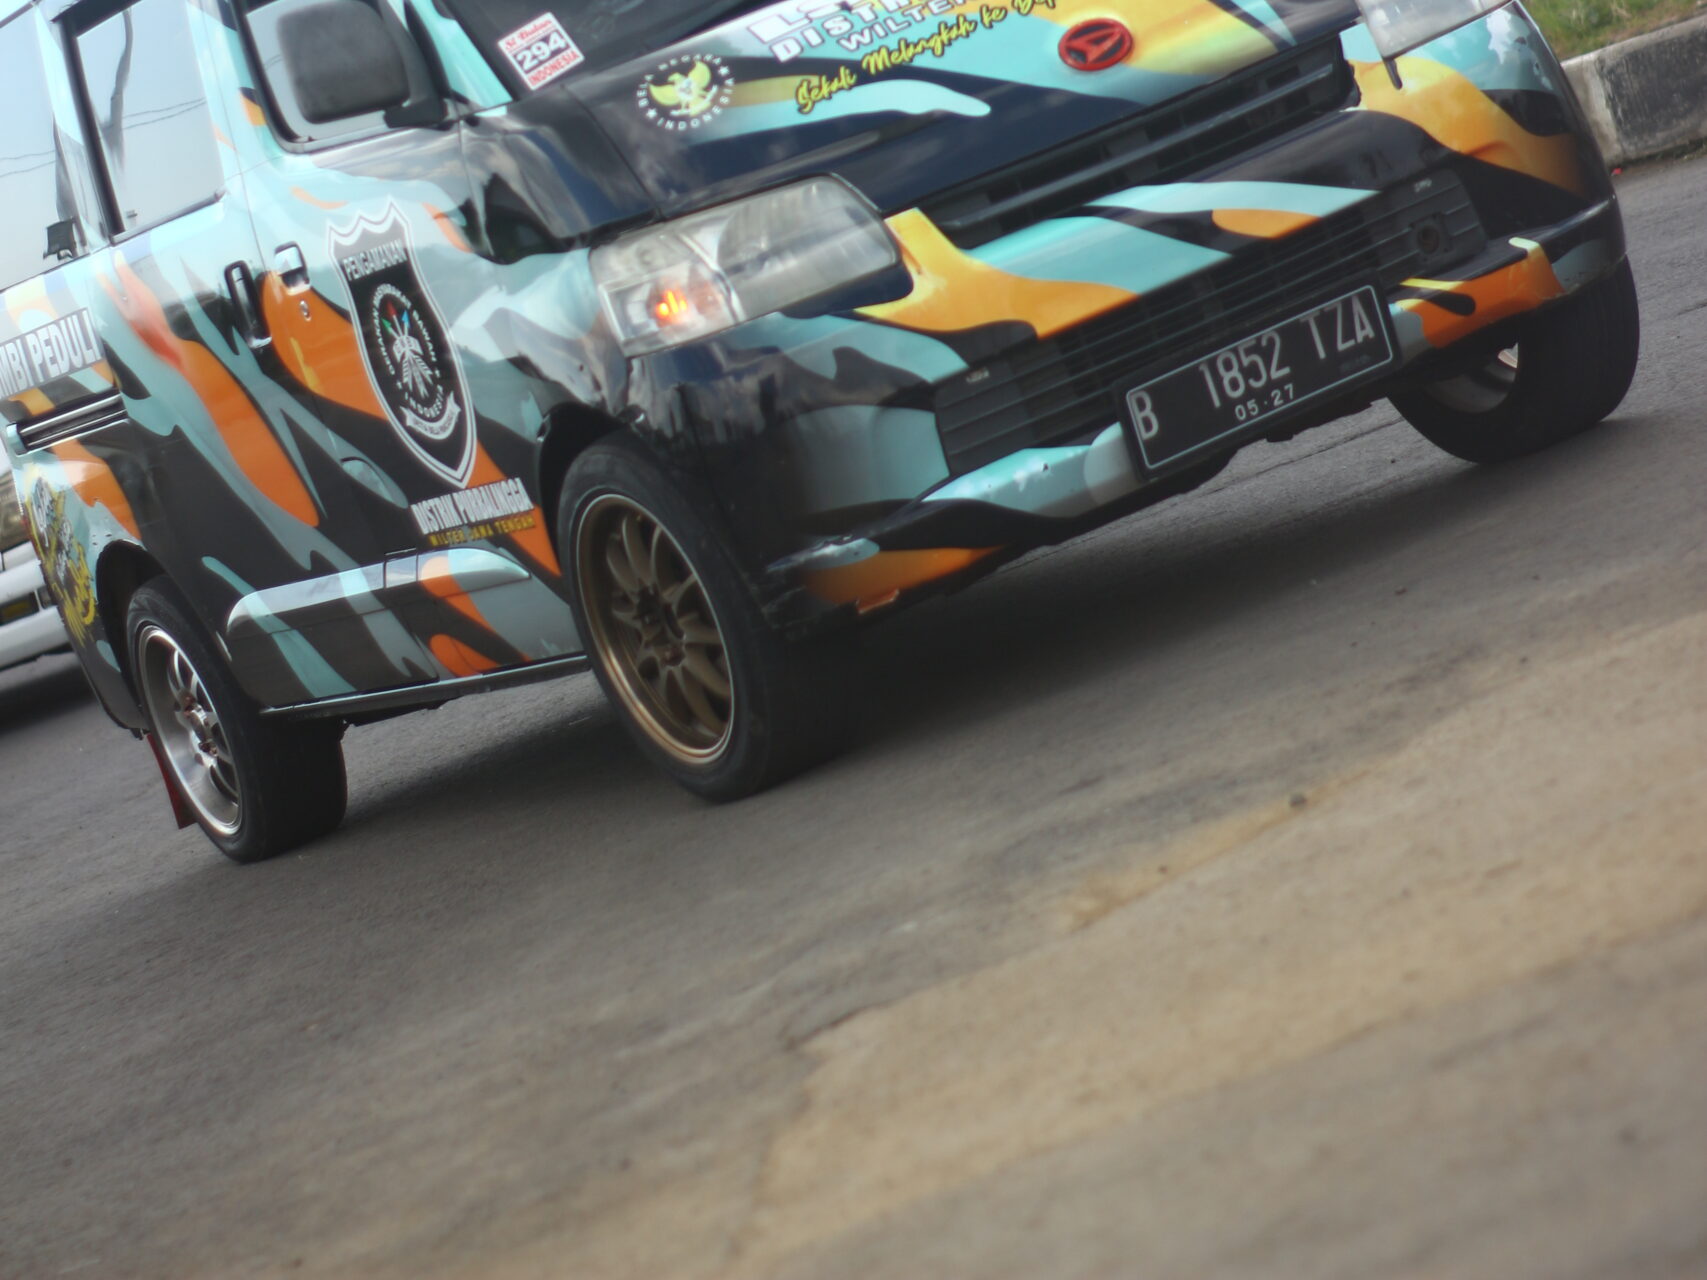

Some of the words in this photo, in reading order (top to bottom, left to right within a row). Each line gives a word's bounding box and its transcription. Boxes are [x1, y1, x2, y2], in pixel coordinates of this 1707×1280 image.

[515, 29, 568, 70] 294
[795, 66, 858, 115] Sekali
[861, 14, 978, 75] Melangkah
[979, 4, 1008, 29] ke
[637, 73, 655, 108] BELA
[658, 53, 722, 72] NEGARA
[656, 76, 736, 131] INDONESIA
[25, 310, 103, 383] PEDULI
[1130, 390, 1160, 441] B
[1198, 330, 1291, 409] 1852
[1300, 294, 1376, 360] TZA
[410, 493, 463, 536] DISTRIK
